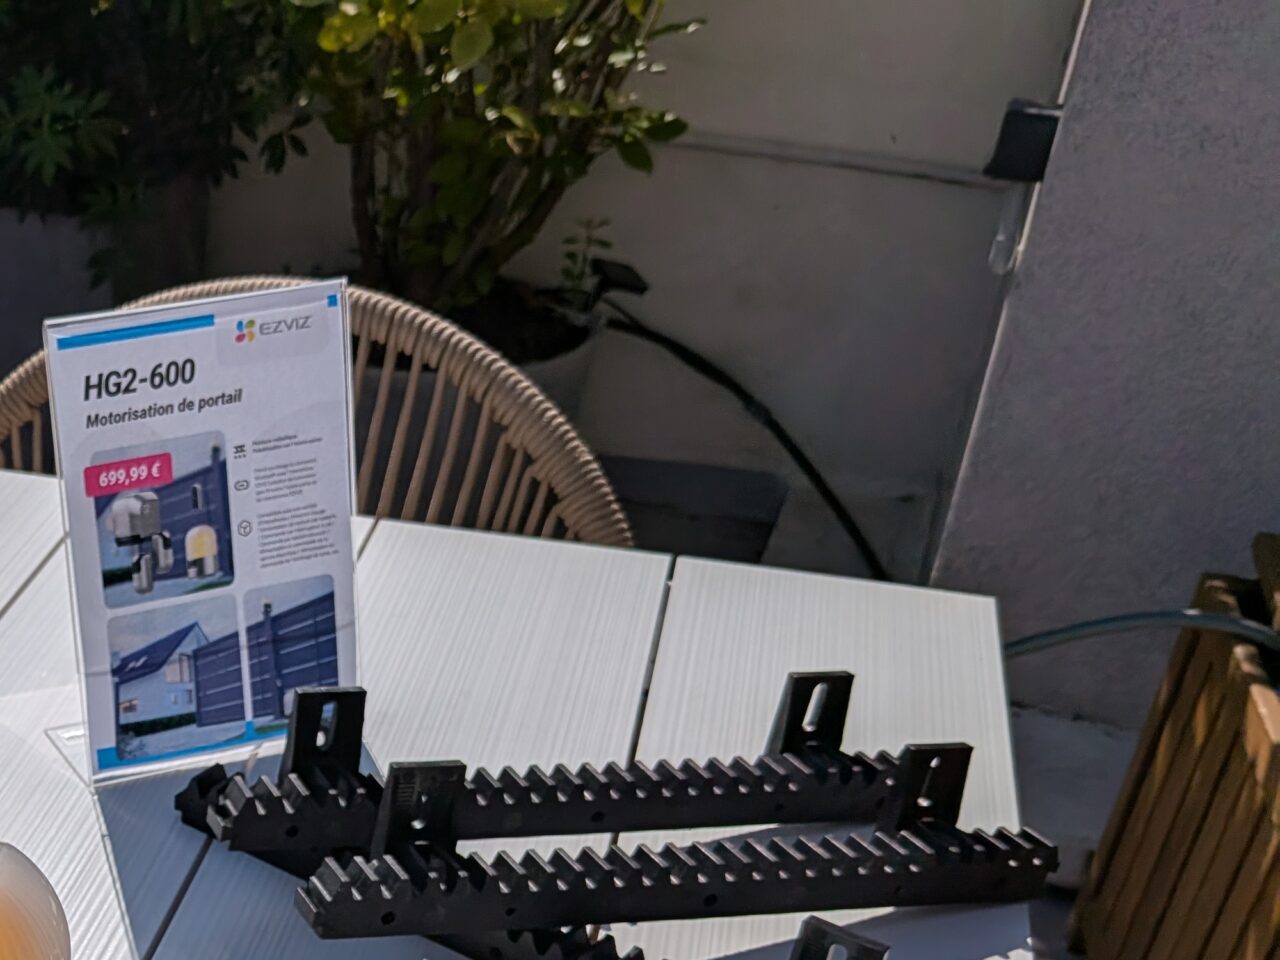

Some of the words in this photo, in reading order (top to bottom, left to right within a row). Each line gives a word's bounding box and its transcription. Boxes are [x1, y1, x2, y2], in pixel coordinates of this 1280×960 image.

[258, 315, 313, 336] EZVIZ
[82, 357, 196, 402] HG2-600
[85, 403, 174, 429] Motorisation
[177, 397, 196, 413] de
[197, 388, 243, 414] portail
[98, 466, 149, 489] 699,99
[151, 461, 161, 478] €
